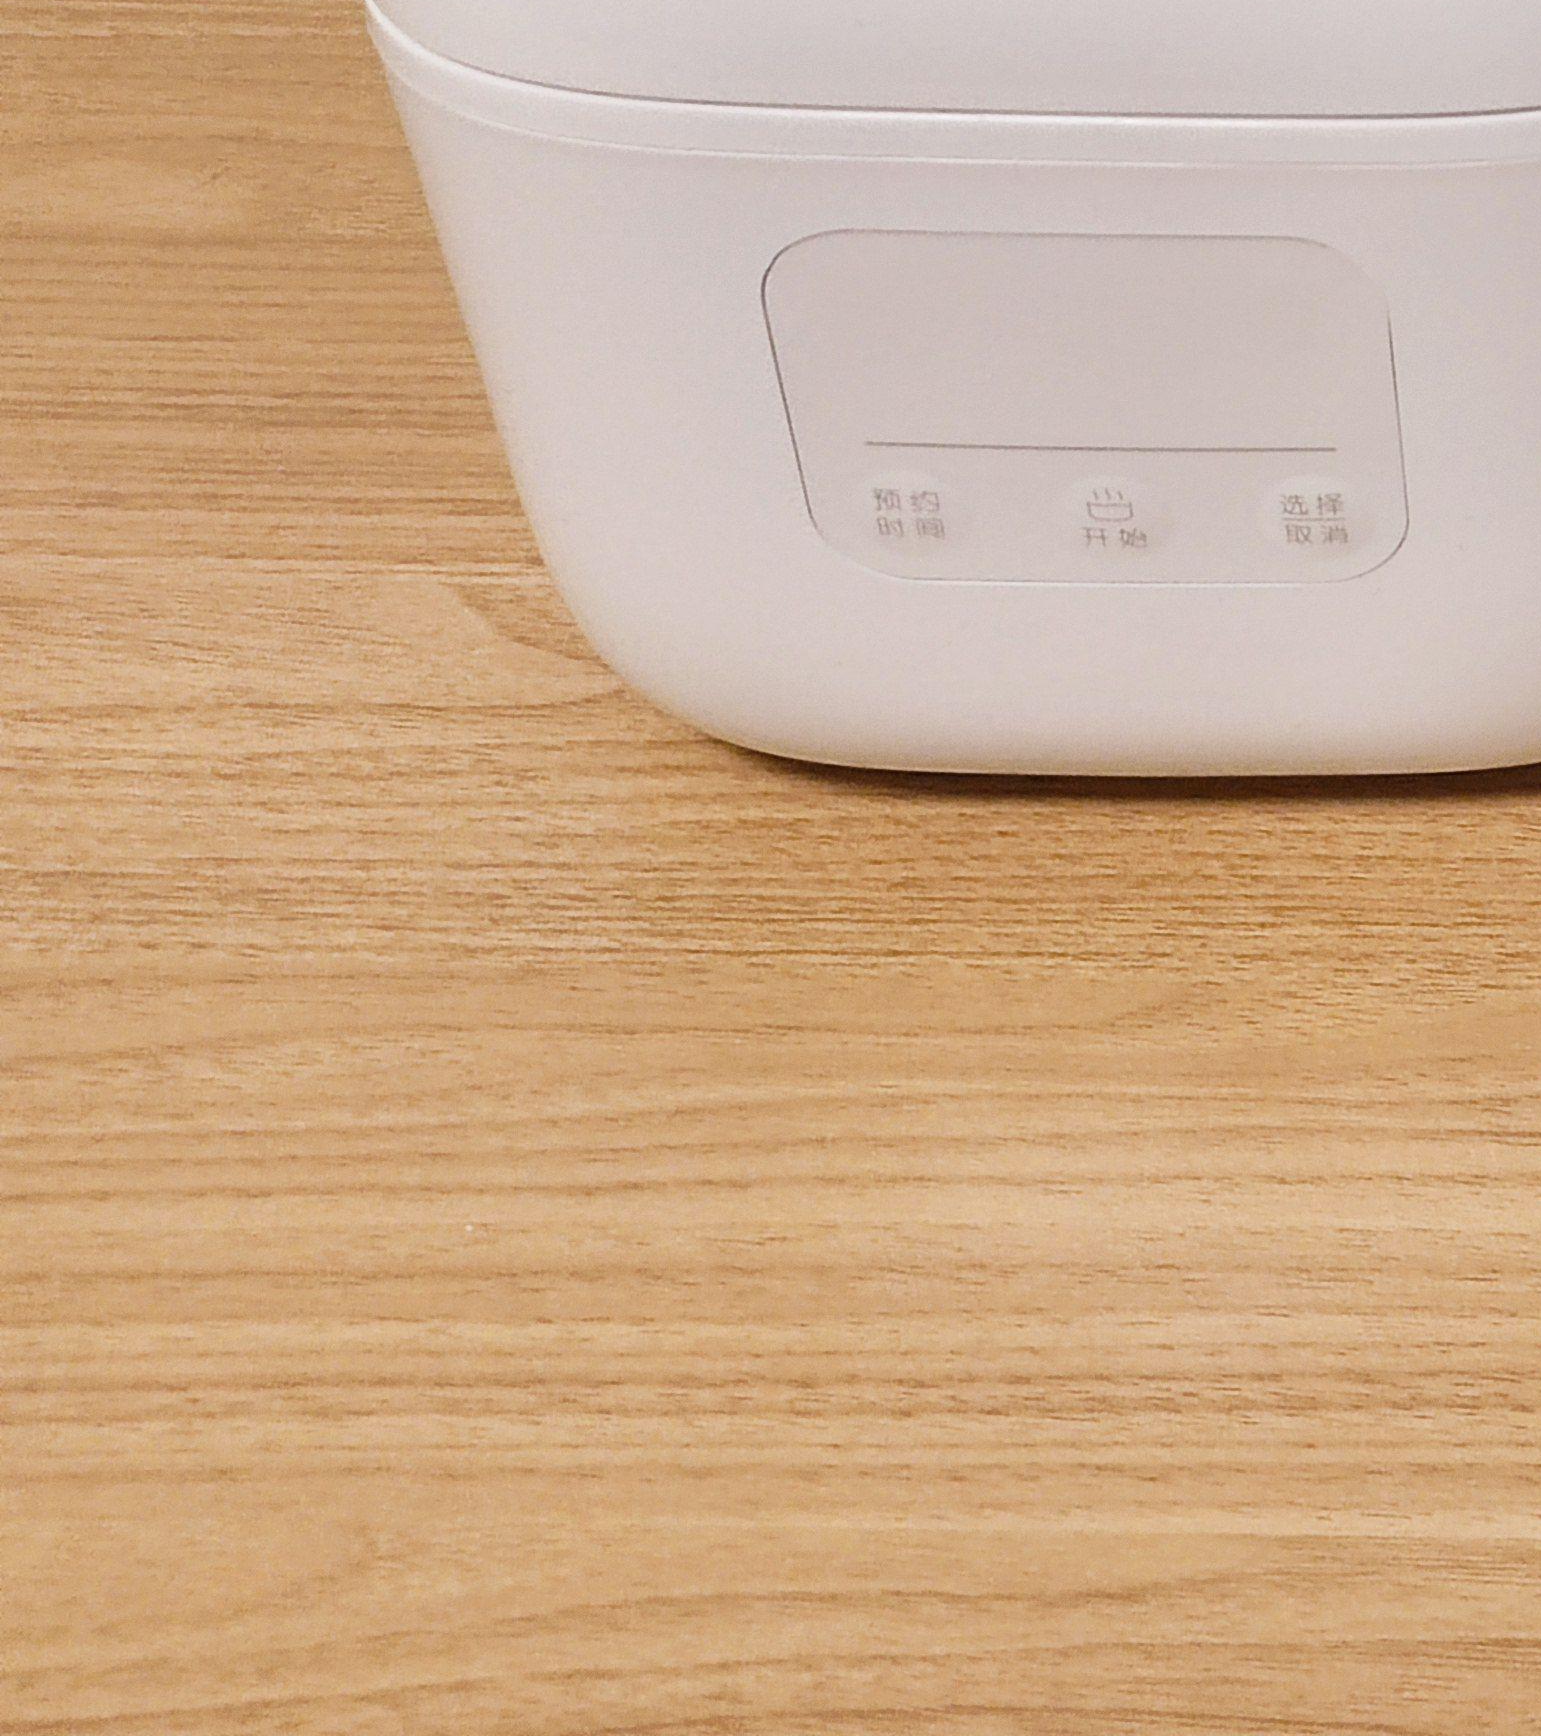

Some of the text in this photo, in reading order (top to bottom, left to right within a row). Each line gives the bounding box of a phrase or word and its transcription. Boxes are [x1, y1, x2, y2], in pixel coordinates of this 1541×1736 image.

[874, 488, 940, 512] 预约
[1280, 493, 1344, 515] 选择
[877, 516, 945, 539] 时间
[1081, 527, 1148, 549] 开始
[1285, 524, 1349, 544] 取消
